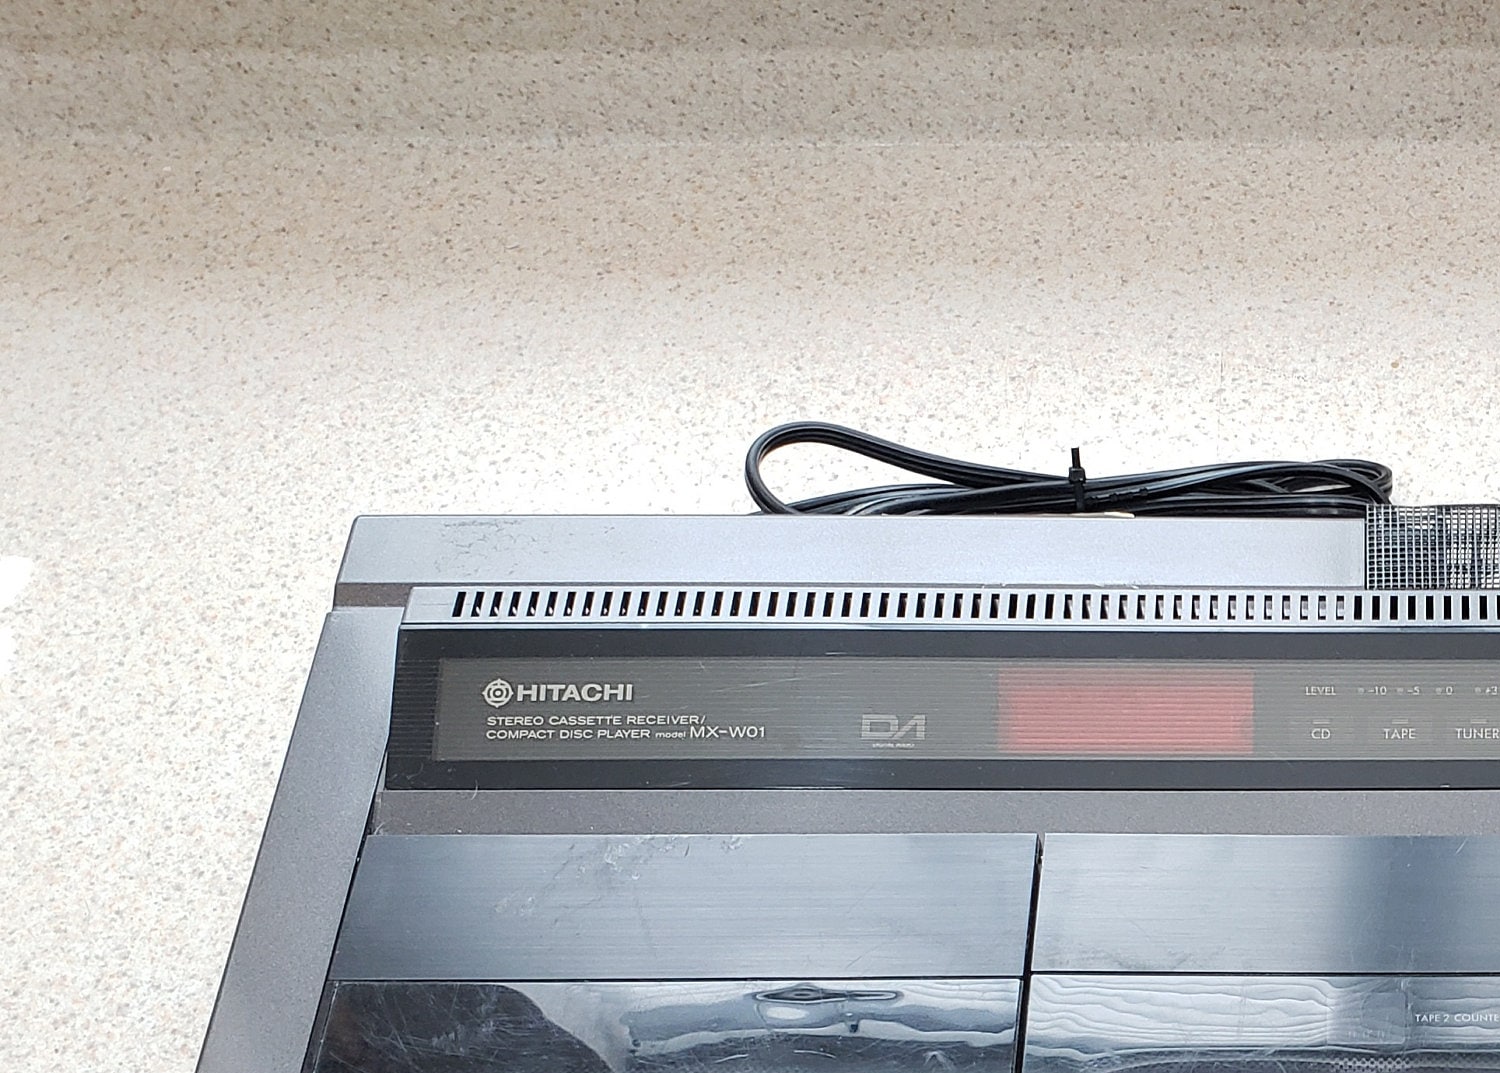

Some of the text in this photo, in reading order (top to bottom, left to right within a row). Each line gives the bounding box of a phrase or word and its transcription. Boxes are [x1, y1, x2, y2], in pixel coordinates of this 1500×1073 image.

[517, 683, 633, 702] HITACHI
[1305, 686, 1336, 696] LEVEL
[486, 714, 706, 726] STEREO CASSETTE RECEIVER/
[486, 725, 766, 740] COMPACT DISC PLAYER model MX-W01
[1311, 728, 1331, 740] CD
[1384, 728, 1416, 740] TAPE
[1455, 727, 1500, 739] TUNER
[1415, 1013, 1439, 1022] TAPE
[1442, 1013, 1450, 1022] 2
